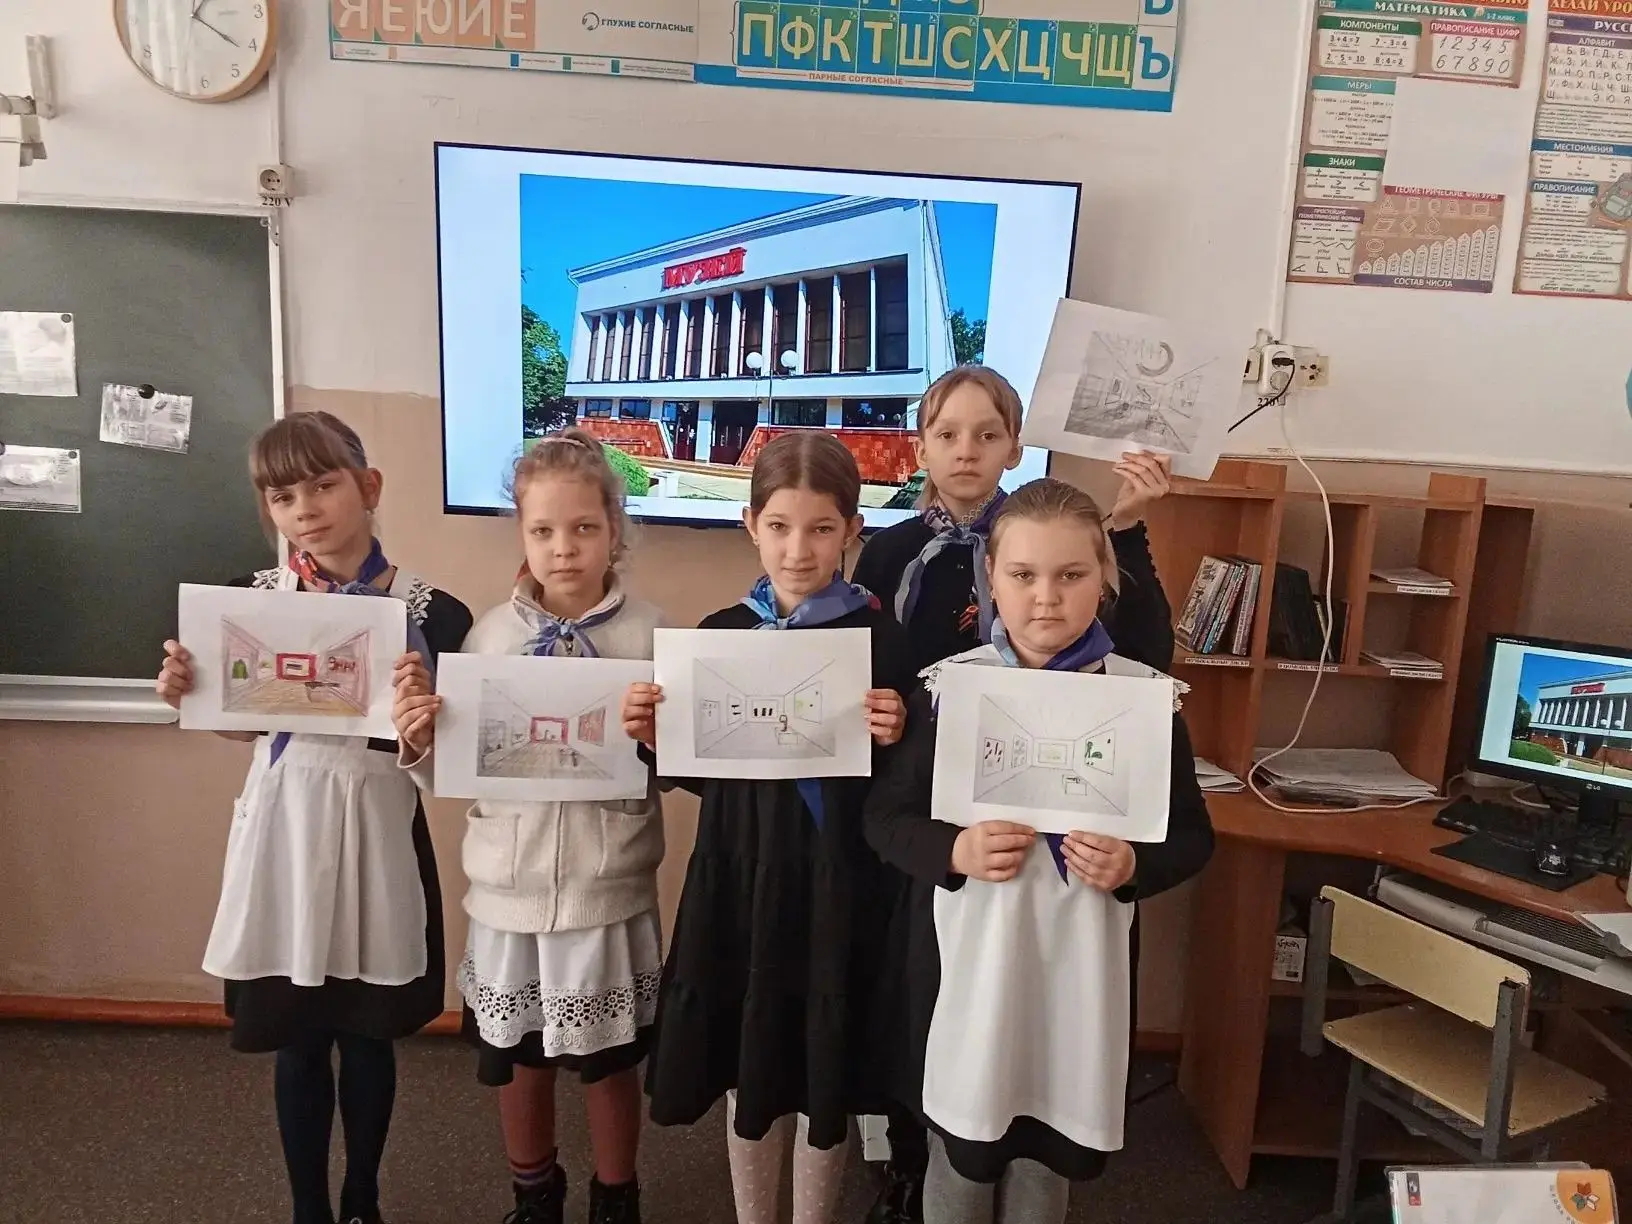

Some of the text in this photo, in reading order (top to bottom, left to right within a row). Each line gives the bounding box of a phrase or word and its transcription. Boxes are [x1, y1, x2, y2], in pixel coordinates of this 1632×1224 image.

[254, 4, 264, 19] 3
[1374, 2, 1468, 17] МАТЕМАТИКА
[601, 18, 694, 33] ГЛУХИЕ СОГЛАСНЫЕ
[1340, 20, 1400, 31] КОМПОНЕНТЫ
[1431, 23, 1521, 37] ПРАВОПИСАНИЕ ЦИФР
[248, 38, 258, 52] 4
[1578, 38, 1616, 47] АЛФАВИТ
[1138, 36, 1171, 80] Ъ
[231, 63, 240, 78] 5
[200, 76, 209, 88] 6
[808, 72, 904, 86] ПАРНЫЕ СОГЛАСНЫЕ
[1347, 81, 1372, 90] МЕРЫ
[1553, 143, 1614, 153] МЕСТОИМЕНИЯ
[1329, 157, 1356, 166] ЗНАКИ
[1533, 183, 1597, 194] ПРАВОПИСАНИЕ
[262, 195, 281, 206] 220
[662, 247, 747, 290] МУЗЕЙ
[1394, 278, 1453, 287] СОСТАВ ЧИСЛА
